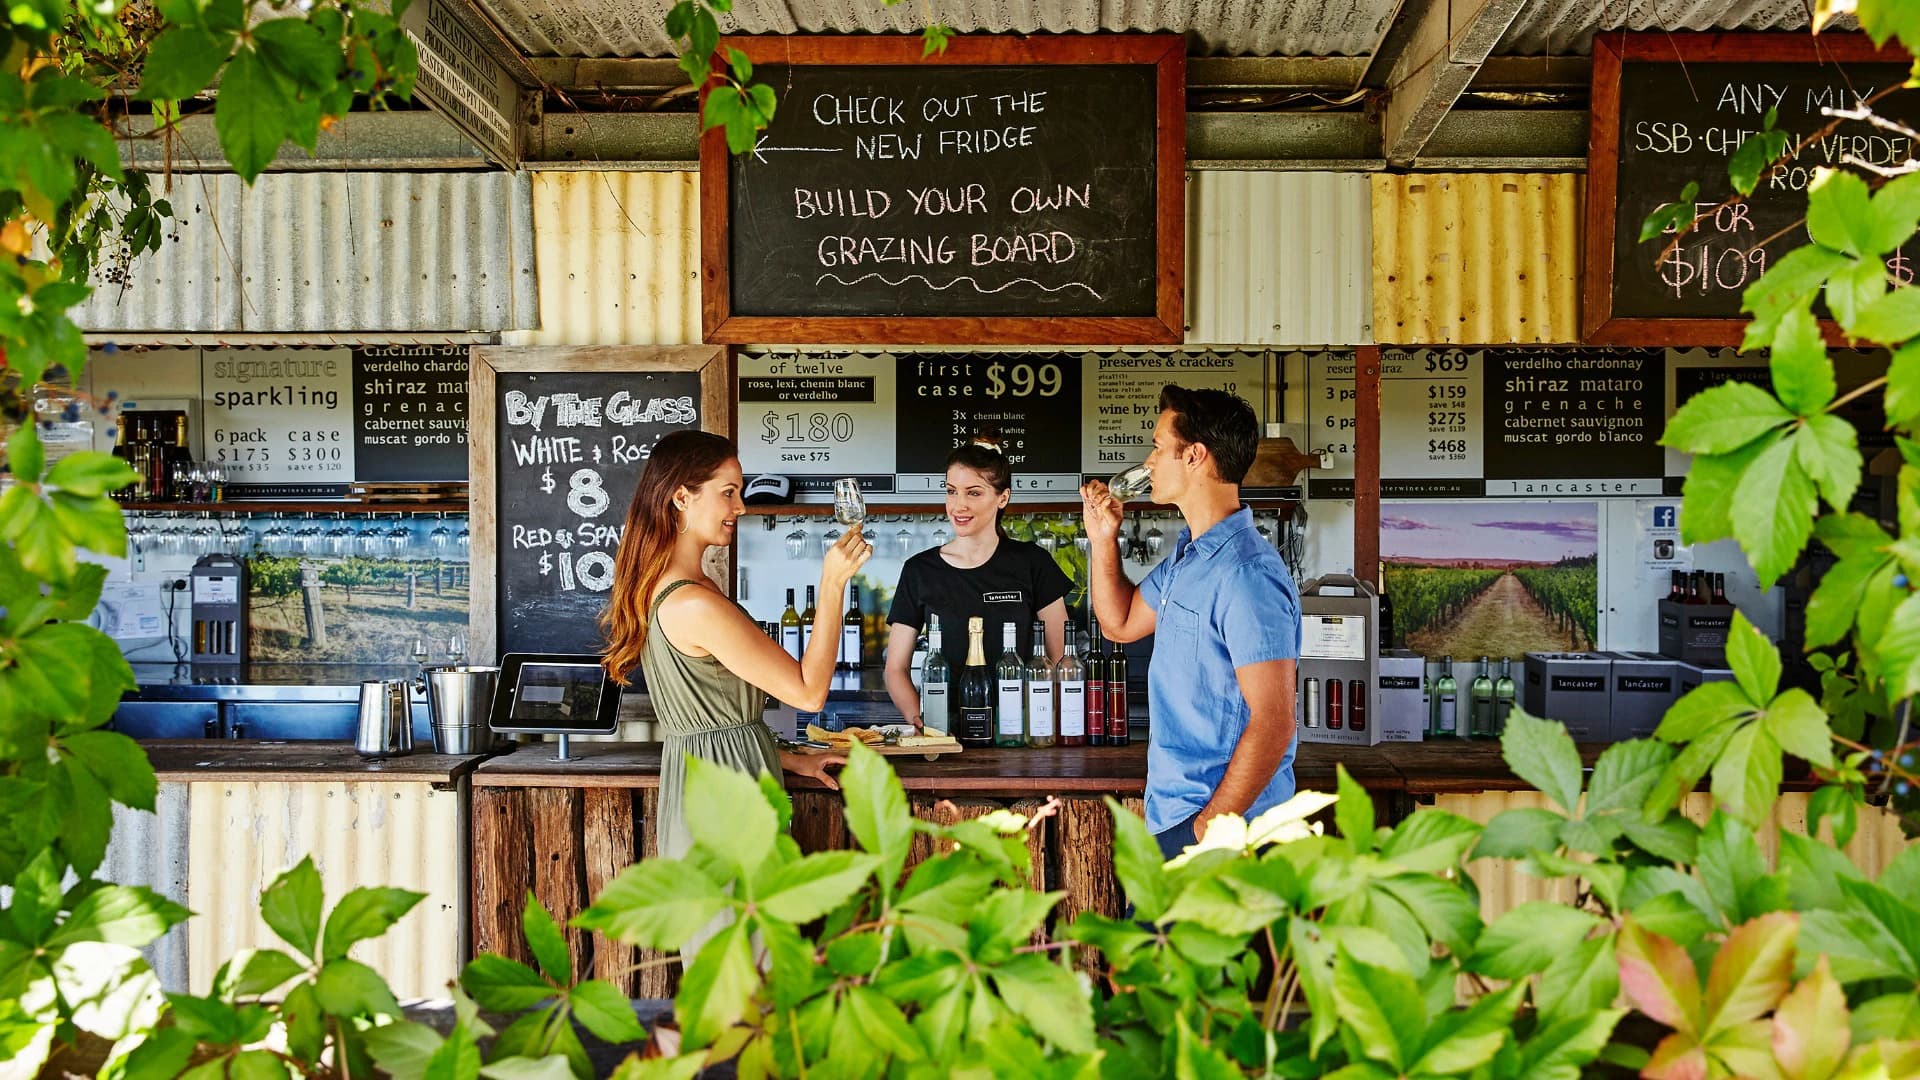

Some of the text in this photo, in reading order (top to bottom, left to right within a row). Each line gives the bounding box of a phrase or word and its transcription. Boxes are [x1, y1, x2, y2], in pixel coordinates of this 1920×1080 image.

[1716, 83, 1788, 115] ANY
[813, 91, 1046, 125] CHECK OUT THE
[855, 126, 1037, 160] NEW FRIDGE
[1635, 121, 1693, 154] SSB
[794, 183, 1090, 219] BUILD YOUR OWN
[1693, 202, 1755, 234] FOR
[818, 231, 1075, 267] GRAZING BOARD
[363, 360, 420, 373] verdelho
[769, 361, 844, 374] of twelve
[918, 362, 972, 377] first
[1098, 356, 1234, 370] preserves & crackers
[1424, 351, 1469, 373] $69
[1504, 358, 1644, 372] verdelho chardonnay
[213, 356, 338, 384] signature
[364, 378, 428, 395] shiraz
[747, 379, 866, 391] rose, lexi, chenin blanc
[985, 361, 1063, 400] $99
[1504, 376, 1644, 393] shiraz mataro
[214, 386, 339, 410] sparkling
[778, 390, 838, 401] or verdelho
[917, 384, 973, 398] case
[1326, 387, 1335, 400] 3
[1428, 385, 1467, 399] $159
[504, 390, 698, 432] BY THE GLASS
[1099, 403, 1129, 415] wine
[1133, 403, 1150, 417] by
[1504, 397, 1643, 412] grenache
[952, 409, 1026, 421] 3x chenin blanc
[1325, 415, 1335, 428] 6
[1428, 412, 1467, 426] $275
[364, 417, 425, 430] cabernet
[761, 410, 854, 445] $180
[952, 424, 967, 435] 3x
[1140, 420, 1154, 430] 10
[1504, 415, 1644, 431] cabernet sauvignon
[214, 428, 340, 446] 6 pack case
[364, 434, 408, 445] muscat
[414, 432, 450, 447] gordo
[1098, 433, 1144, 445] t-shirts
[1504, 431, 1644, 445] muscat gordo blanco
[512, 434, 584, 467] WHITE
[1428, 439, 1467, 454] $468
[217, 447, 341, 462] $175 $300
[780, 451, 831, 463] save $75
[1098, 450, 1126, 461] hats
[1511, 480, 1638, 493] lancaster
[513, 525, 552, 550] RED
[1558, 679, 1598, 689] lancaster
[1624, 679, 1664, 689] lancaster
